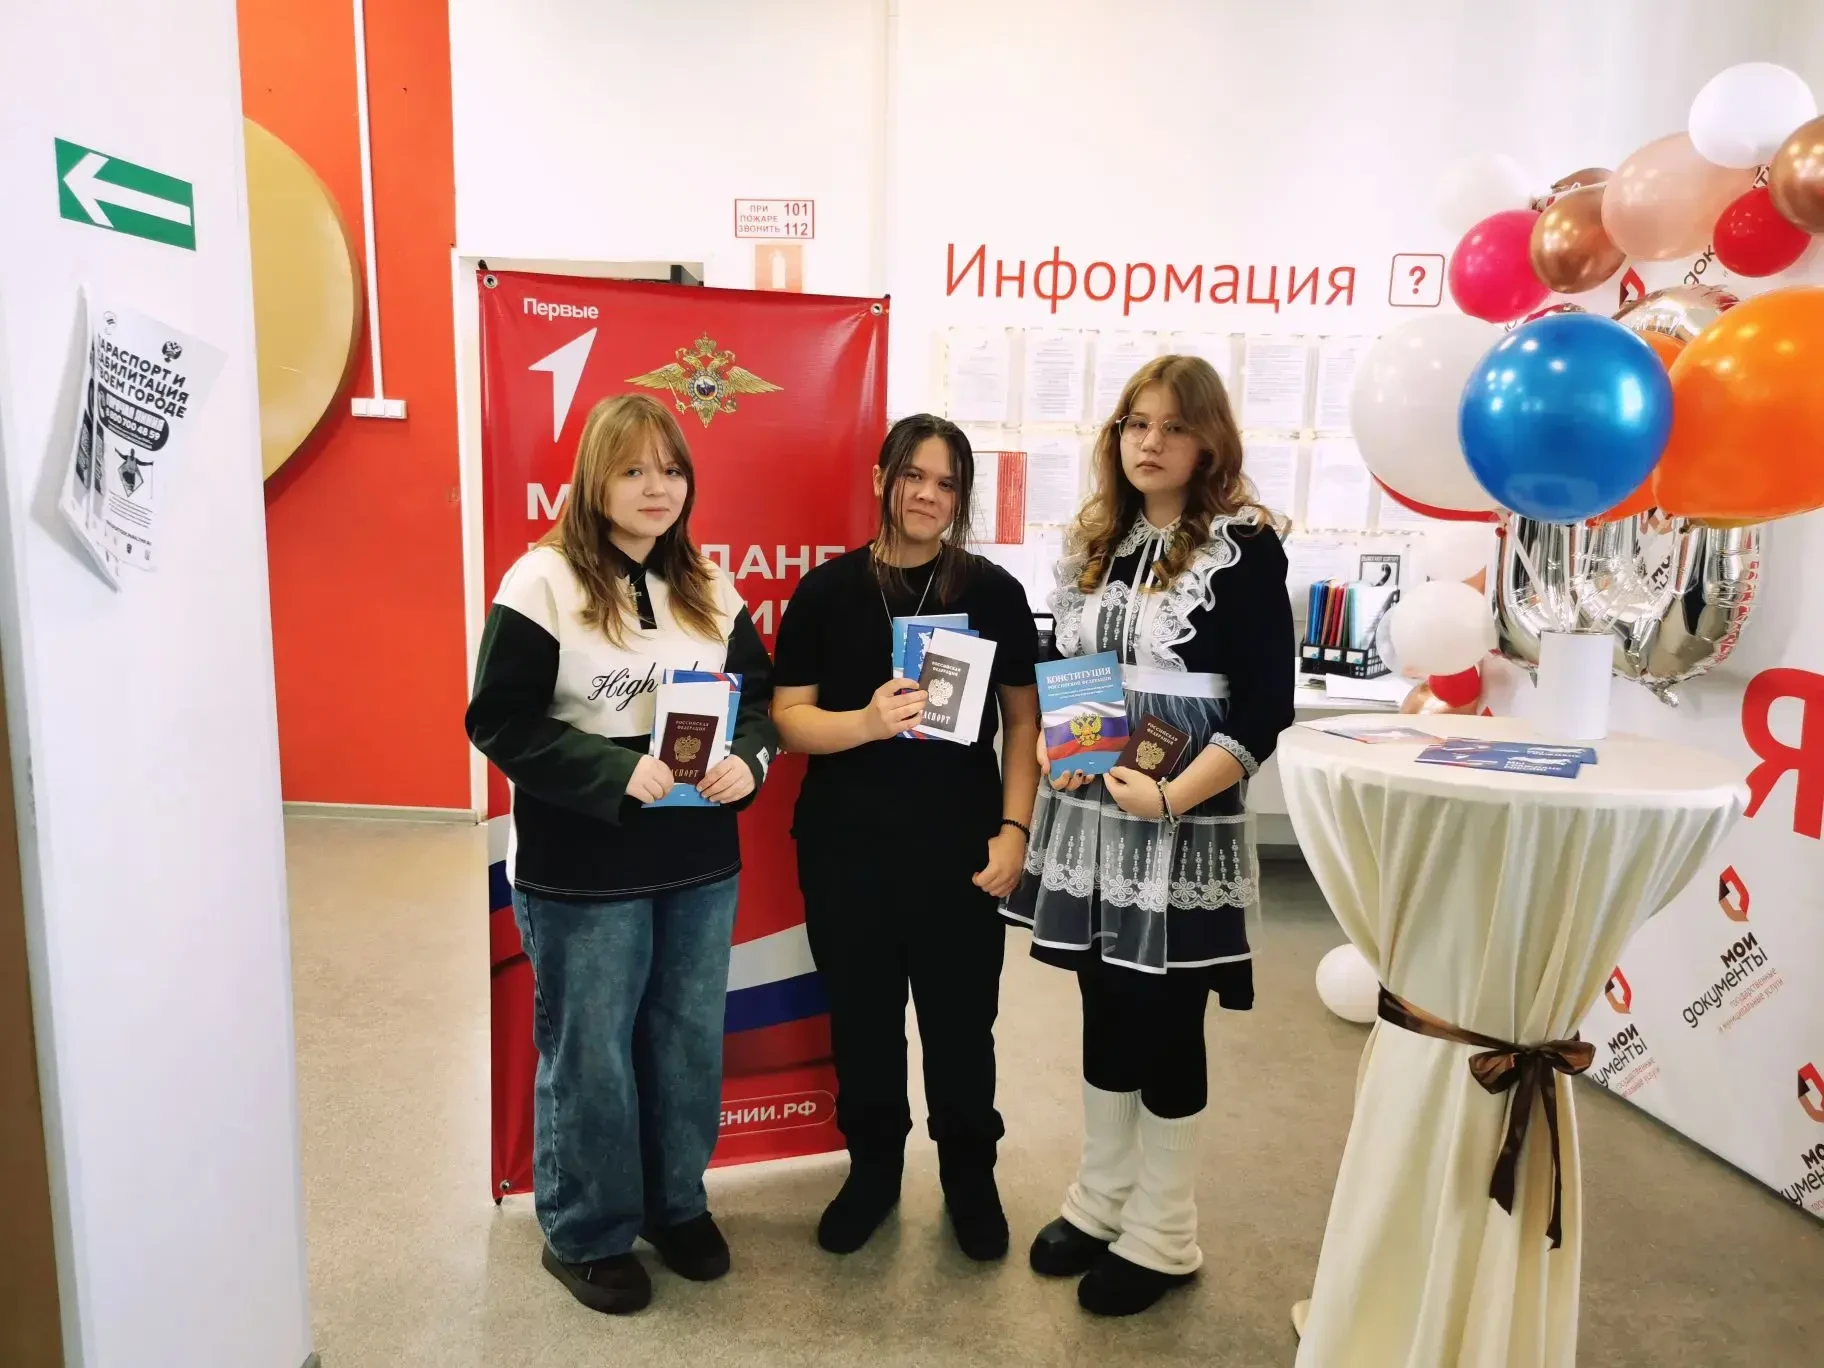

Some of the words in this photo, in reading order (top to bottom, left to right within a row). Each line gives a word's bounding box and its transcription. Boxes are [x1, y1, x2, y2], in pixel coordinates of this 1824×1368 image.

[739, 215, 779, 223] ПОЖАРЕ
[750, 204, 769, 213] ПРИ
[784, 202, 808, 217] 101
[738, 224, 781, 233] ЗВОНИТЬ
[784, 222, 808, 236] 112
[946, 243, 1356, 316] Информация
[523, 297, 599, 321] Первые
[97, 333, 172, 381] АРАСПОРТ
[172, 373, 187, 388] И
[97, 350, 190, 405] АБИЛИТАЦИЯ
[127, 384, 188, 419] ГОРОДЕ
[587, 661, 659, 712] High
[1046, 667, 1112, 684] КОНСТИТУЦИЯ
